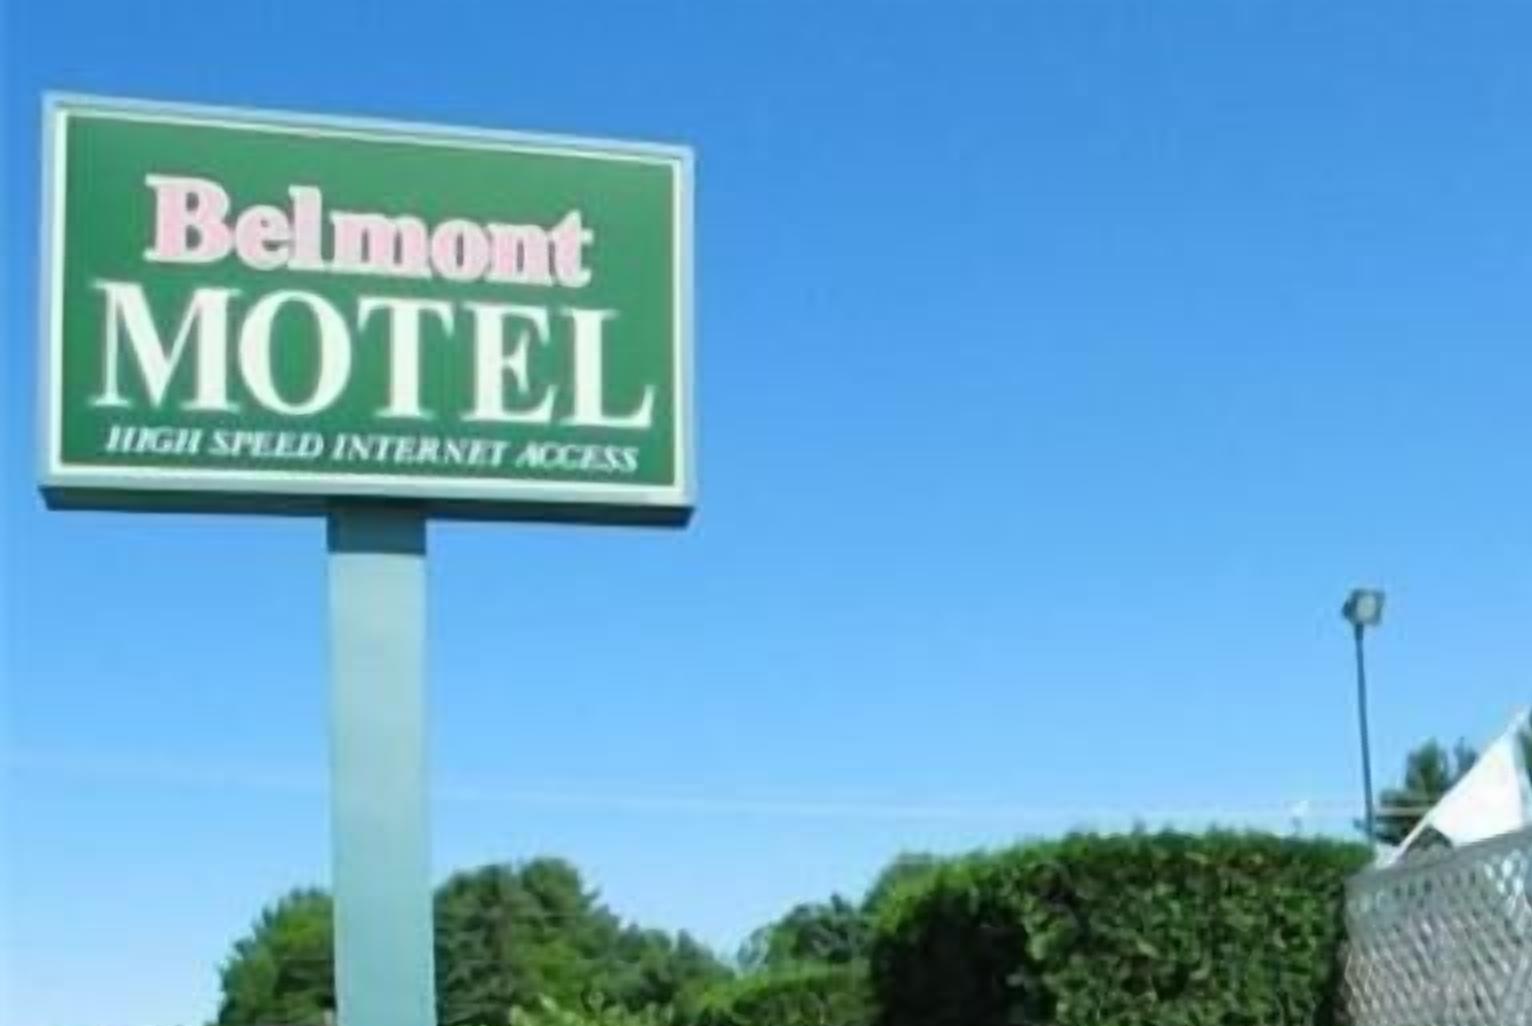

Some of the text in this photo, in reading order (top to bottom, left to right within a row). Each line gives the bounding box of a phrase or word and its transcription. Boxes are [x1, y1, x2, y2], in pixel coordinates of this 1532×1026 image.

[143, 173, 594, 287] Belmont
[90, 279, 659, 429] MOTEL
[105, 426, 639, 472] HIGH SPEED INTERNET ACCESS
